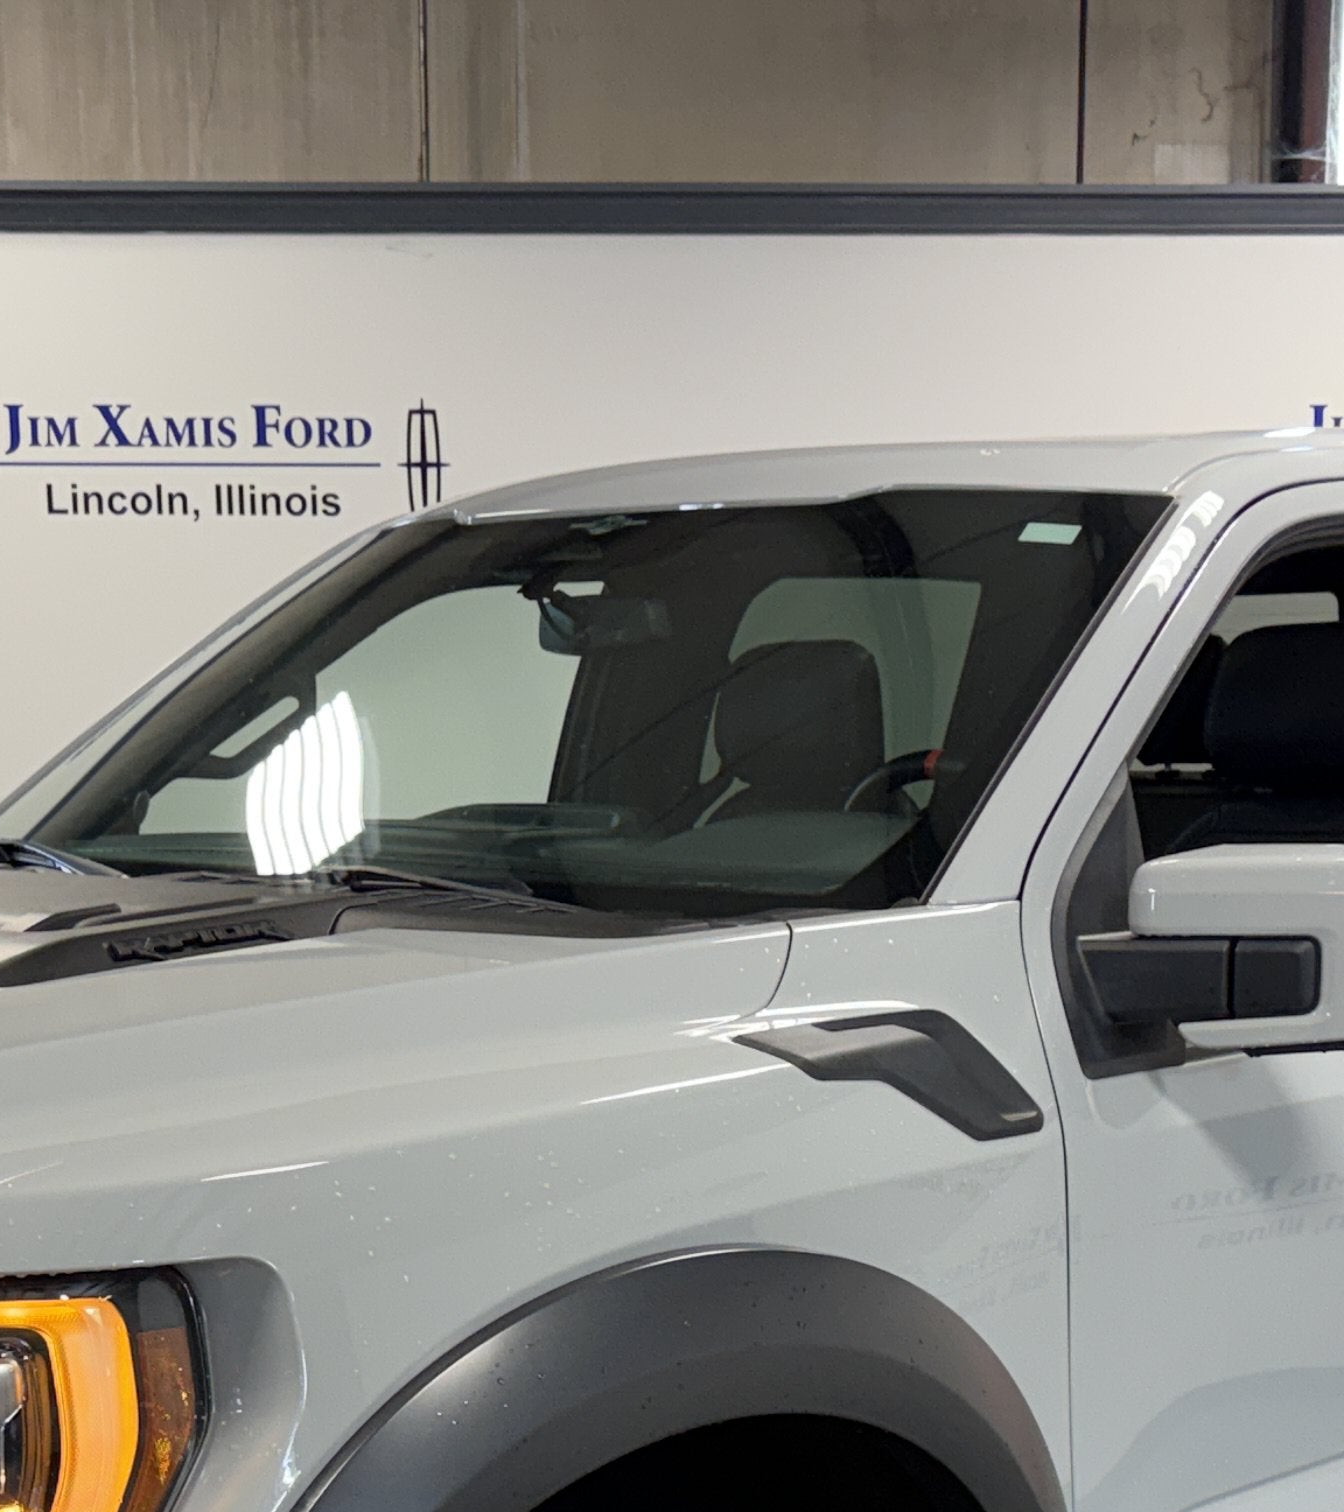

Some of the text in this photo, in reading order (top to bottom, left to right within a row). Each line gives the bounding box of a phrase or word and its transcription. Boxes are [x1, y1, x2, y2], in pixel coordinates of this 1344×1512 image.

[3, 404, 373, 455] JIM XAMIS FORD
[46, 483, 342, 521] Lincoln, Illinois
